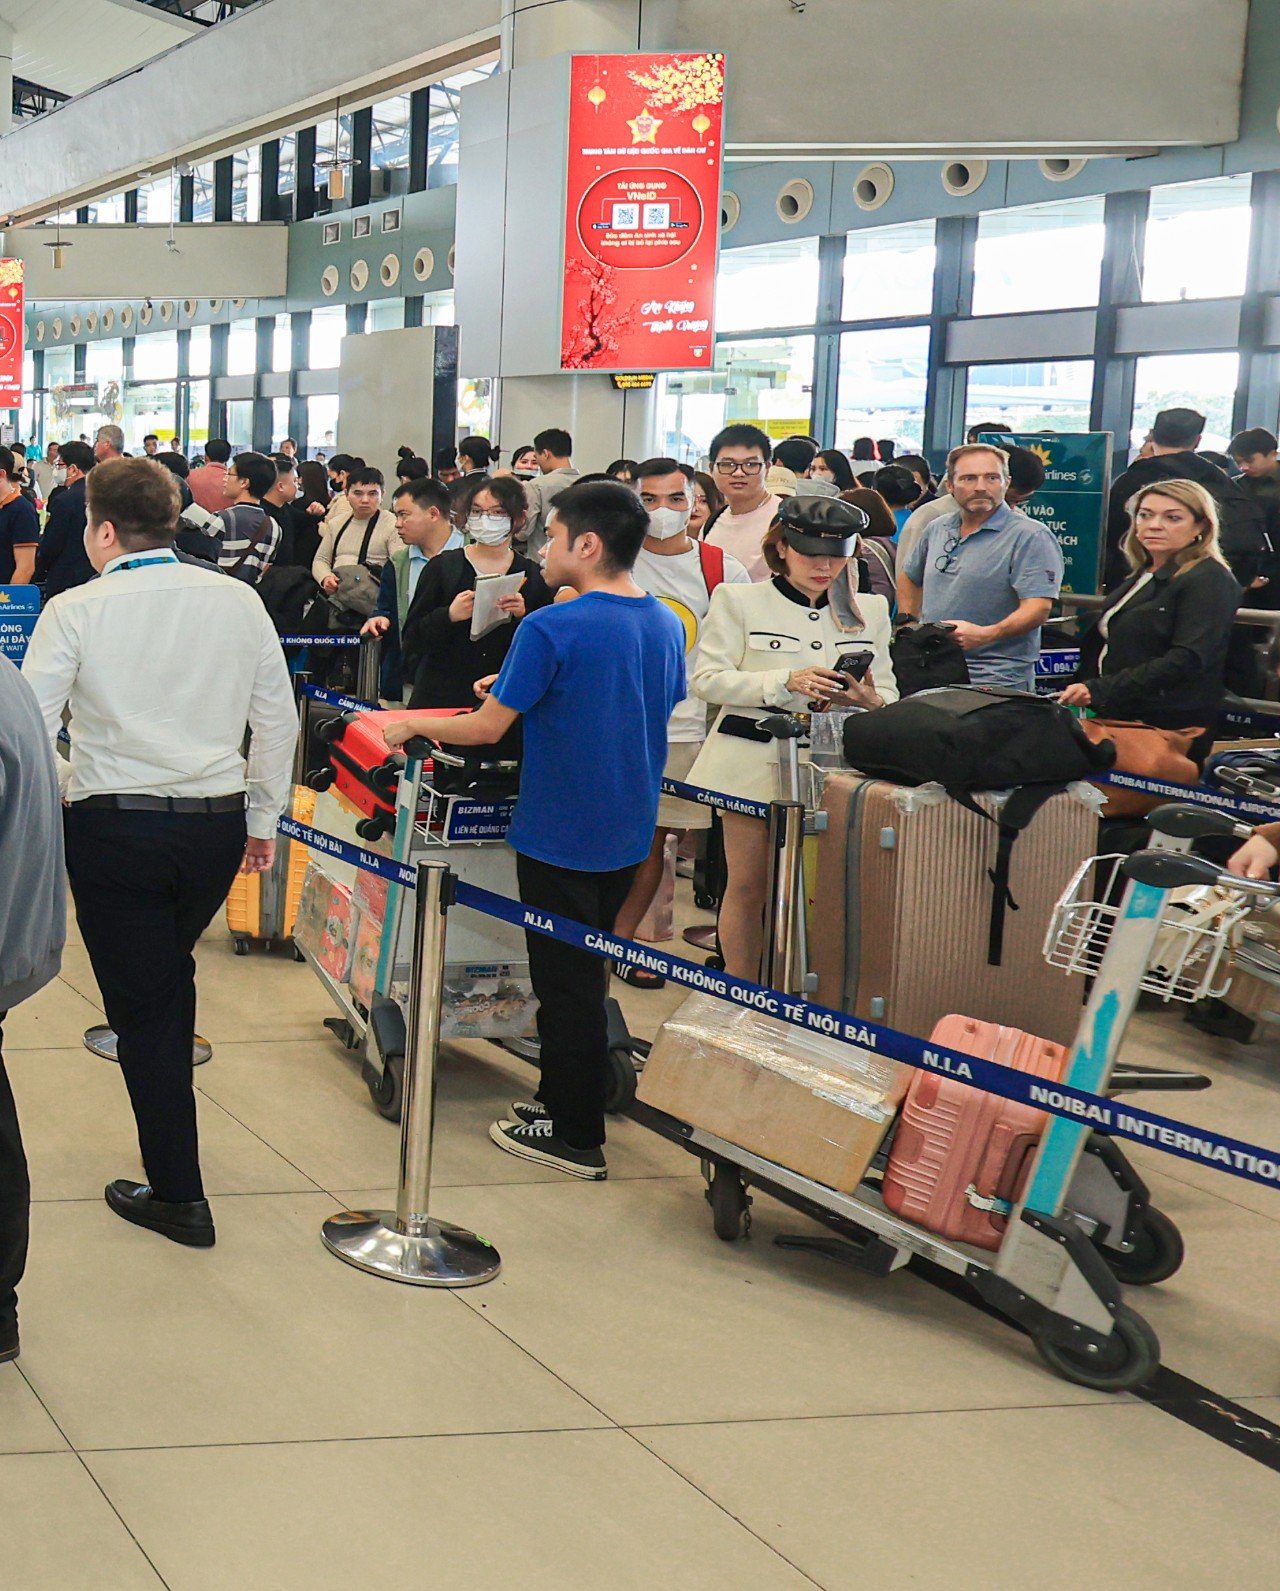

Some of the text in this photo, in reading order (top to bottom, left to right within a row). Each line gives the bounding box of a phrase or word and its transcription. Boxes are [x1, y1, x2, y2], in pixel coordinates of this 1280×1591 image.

[627, 192, 657, 201] VNeID
[1045, 469, 1077, 481] irlines
[1032, 504, 1055, 516] VÀO
[1058, 534, 1078, 546] ÁCH
[286, 635, 360, 646] KHÔNG QUỐC TẾ NỘI
[6, 644, 24, 652] WAIT
[314, 689, 328, 701] N.I.A
[338, 697, 355, 709] CẢNG
[660, 782, 677, 794] .I.A
[696, 791, 725, 808] CẢNG
[726, 799, 756, 815] HÀNG
[1109, 773, 1280, 820] NOIBAI INTERNATIONAL AIRPO
[458, 805, 495, 815] BIZMAN
[454, 823, 510, 835] LIÊN HỆ QUẢNG CÁ
[281, 820, 301, 838] QUỐC
[302, 828, 313, 842] TẾ
[313, 834, 328, 850] NỘI
[328, 839, 343, 854] BÀI
[359, 852, 380, 869] N.I.A
[524, 911, 1280, 1183] N.I.A CẢNG HÀNG KHÔNG QUỐC TẾ NỘI BÀI N.I.A NOIBAI INTERNATIO
